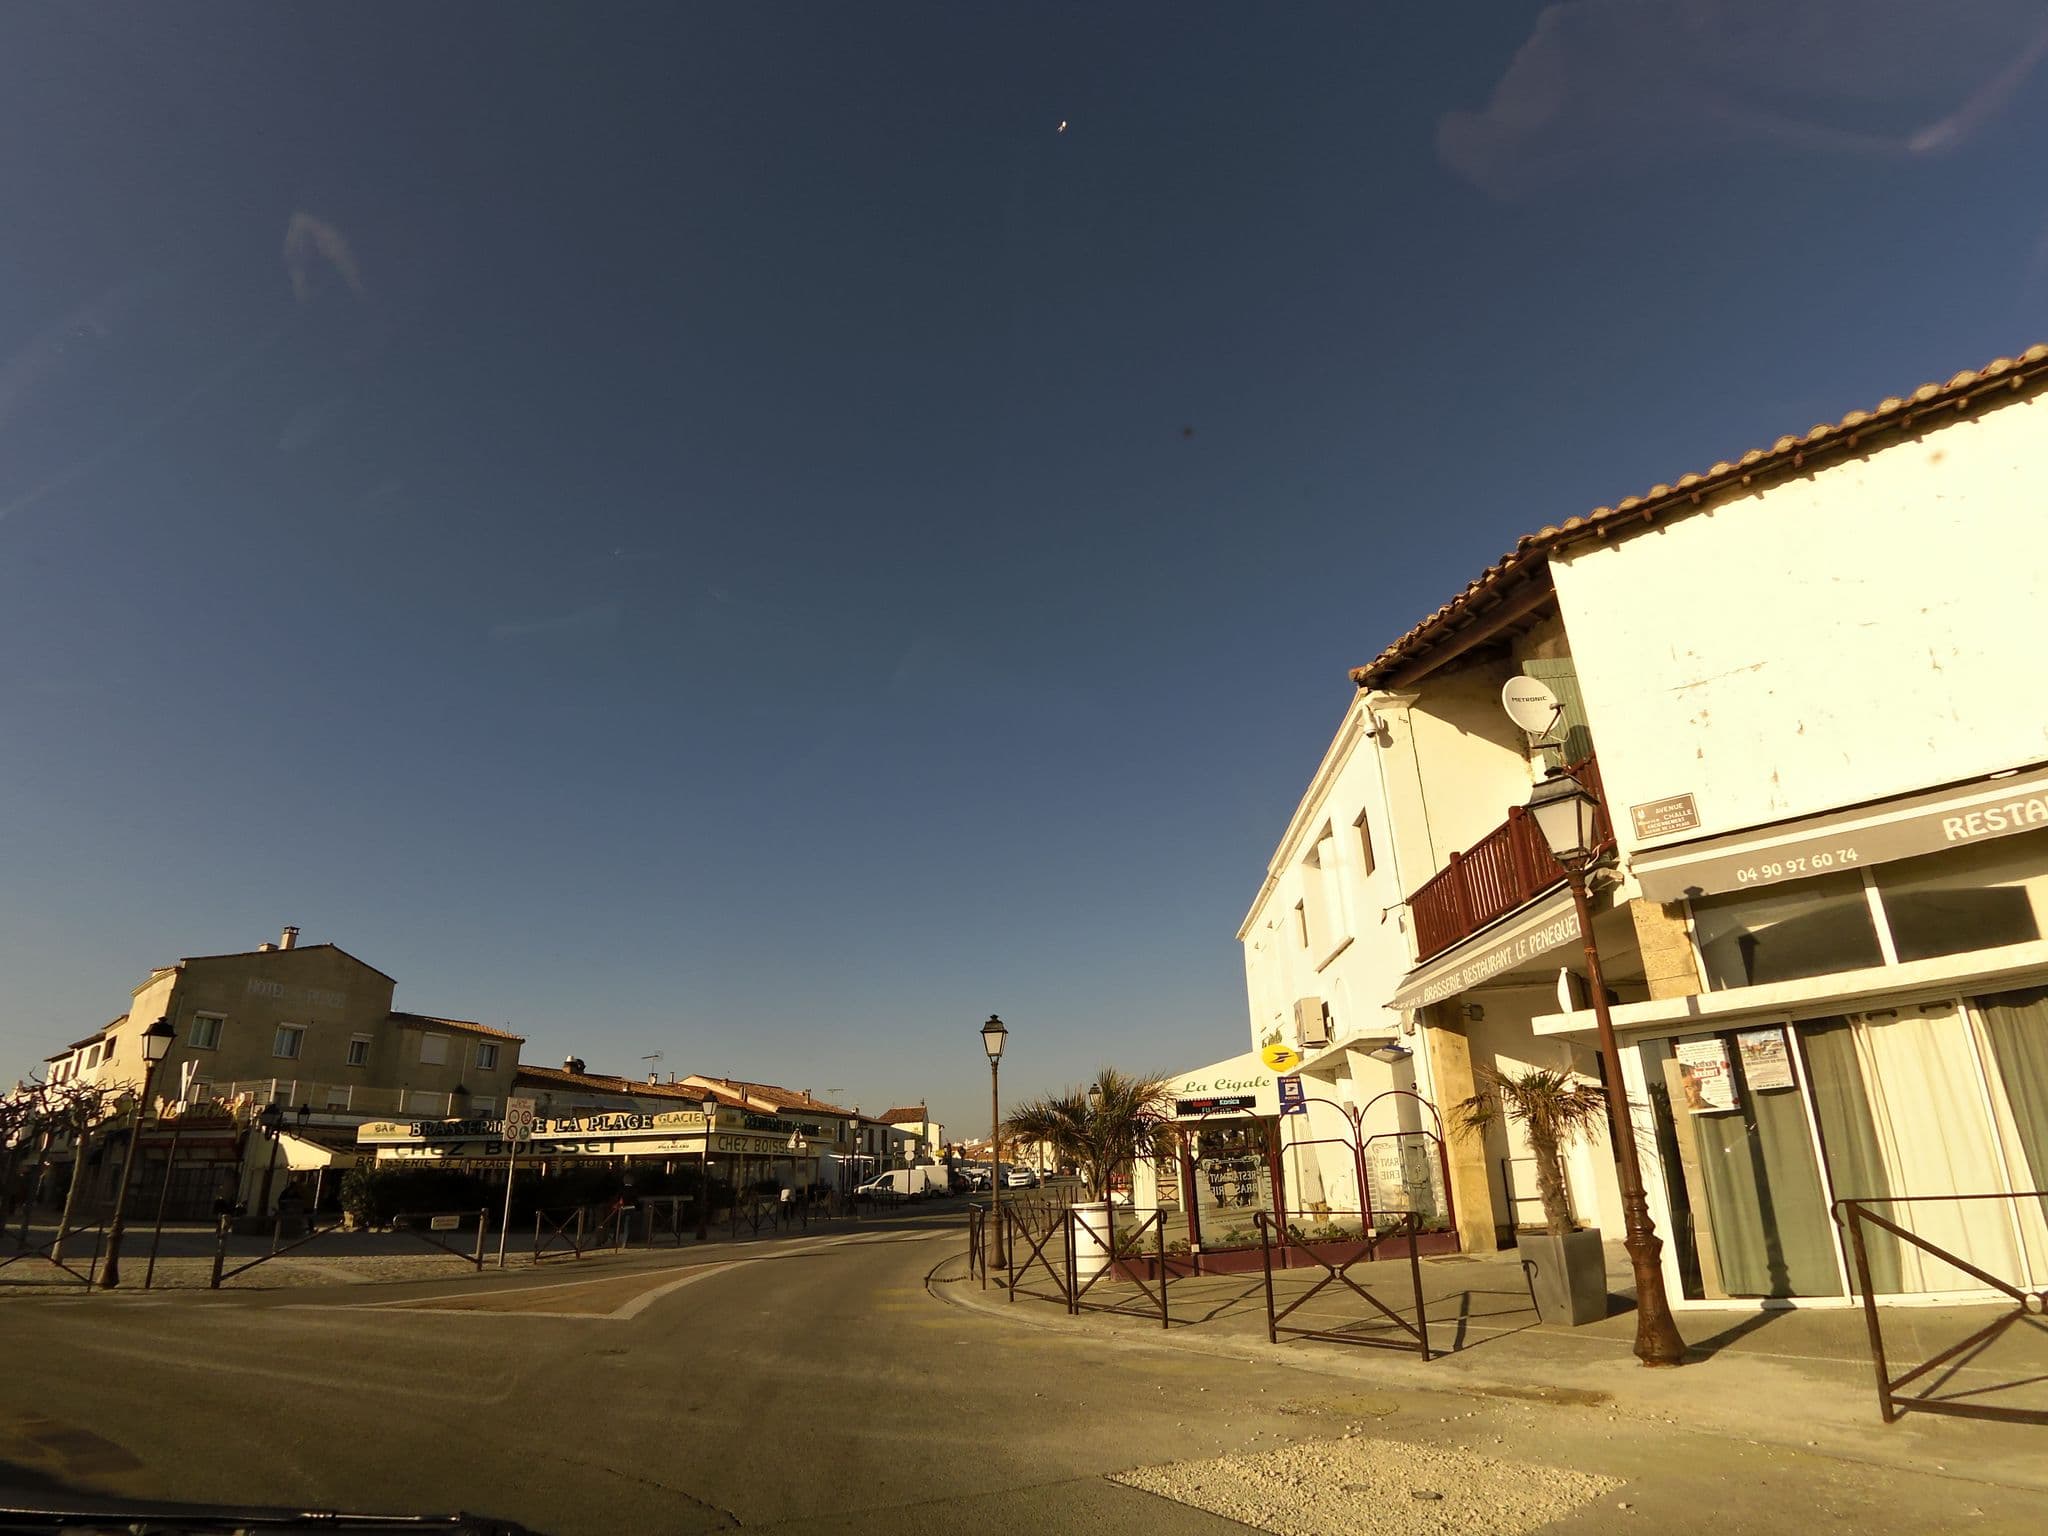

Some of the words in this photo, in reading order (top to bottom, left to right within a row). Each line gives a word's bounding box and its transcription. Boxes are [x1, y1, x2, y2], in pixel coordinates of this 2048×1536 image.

[1655, 803, 1684, 814] AVENUE
[1737, 868, 1757, 883] 04
[1762, 863, 1782, 878] 90
[1786, 858, 1806, 874] 97
[1812, 853, 1833, 868] 60
[1836, 847, 1858, 863] 74
[1424, 973, 1462, 1002] BRASSERIE
[1463, 947, 1513, 983] RESTAURANT
[1516, 940, 1528, 959] LE
[1183, 1081, 1208, 1093] La
[1214, 1076, 1271, 1092] Cigale
[375, 1122, 396, 1133] BAR
[554, 1117, 582, 1132] LA
[587, 1114, 654, 1131] PLAGE
[717, 1135, 749, 1151] CHEZ
